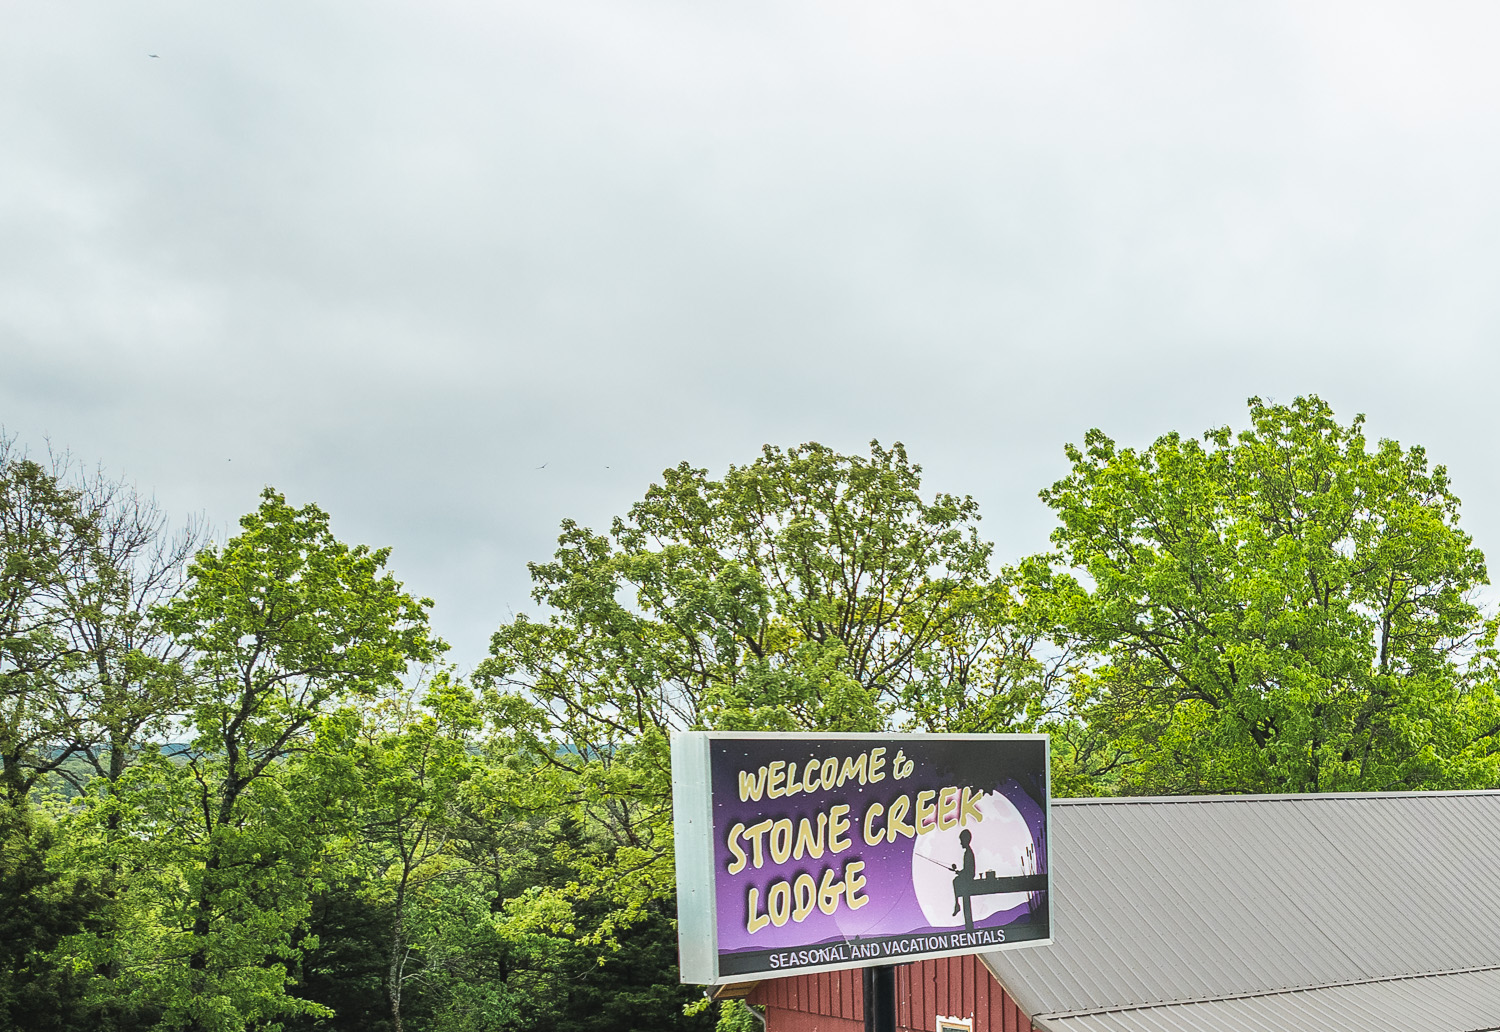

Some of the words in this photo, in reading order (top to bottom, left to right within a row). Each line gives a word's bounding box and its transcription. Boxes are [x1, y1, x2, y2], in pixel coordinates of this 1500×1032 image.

[738, 747, 886, 802] WELCOME
[893, 750, 914, 780] to
[728, 804, 852, 875] STONE
[864, 786, 983, 846] CREEK
[747, 861, 869, 934] LODGE
[769, 943, 848, 969] SEASONAL
[851, 942, 880, 959] AND
[882, 936, 948, 955] VACATION
[950, 929, 1006, 948] RENTALS
